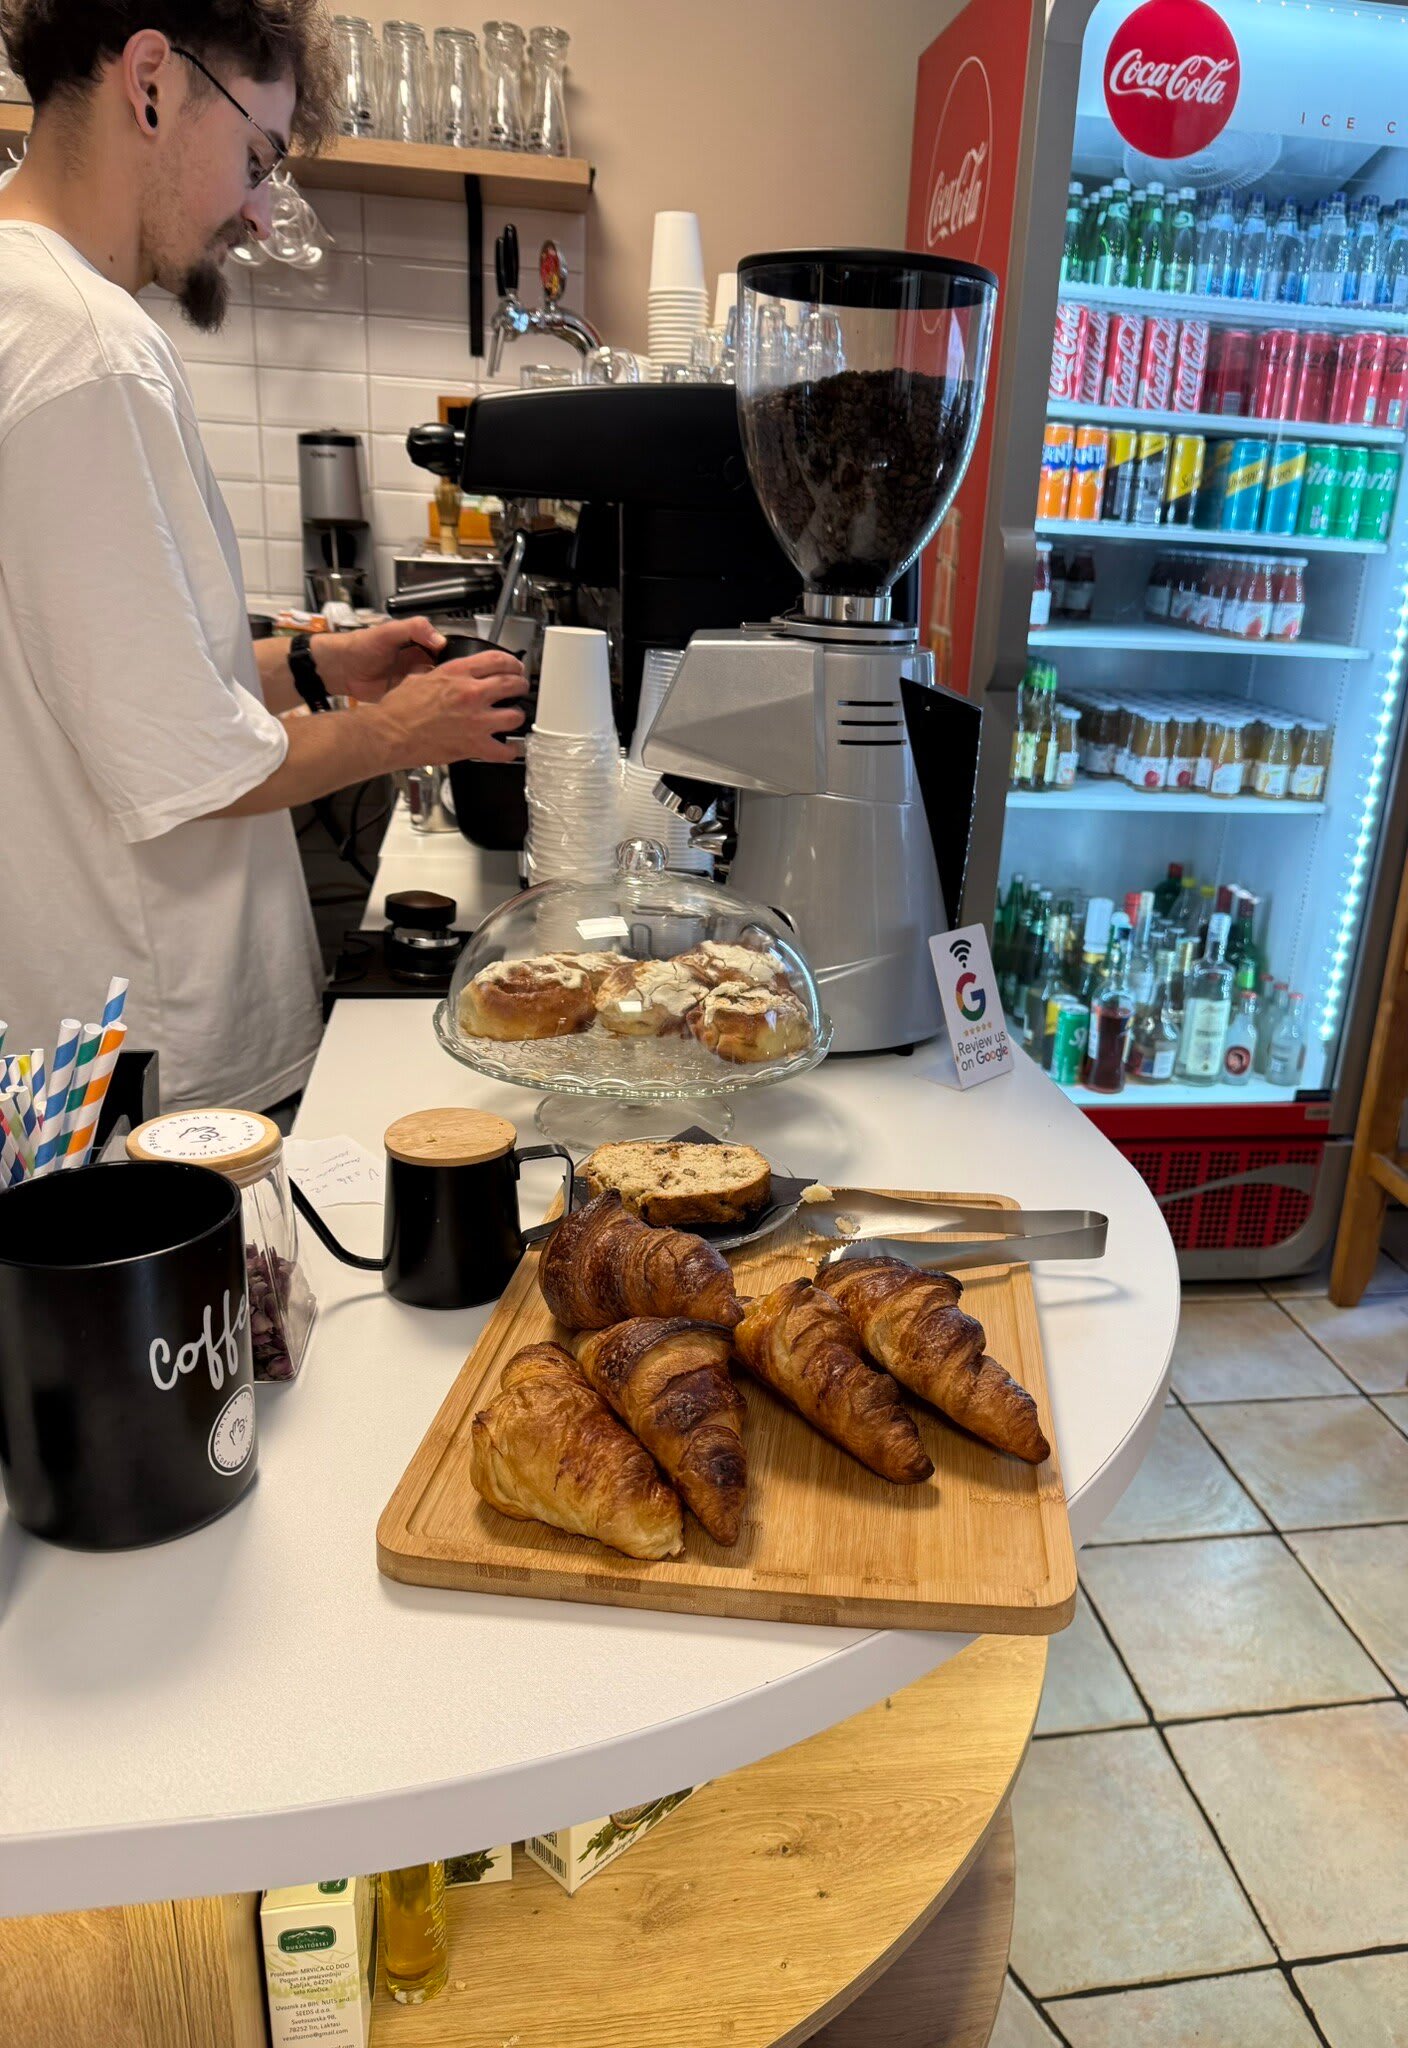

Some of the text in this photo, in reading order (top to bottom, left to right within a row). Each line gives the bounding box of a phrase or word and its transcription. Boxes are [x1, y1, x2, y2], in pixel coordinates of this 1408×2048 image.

[1301, 112, 1356, 130] ICE
[957, 1030, 1006, 1057] Review us
[961, 1044, 1008, 1071] on Google
[321, 1998, 338, 2006] NUTS
[295, 2008, 315, 2017] SEEDS
